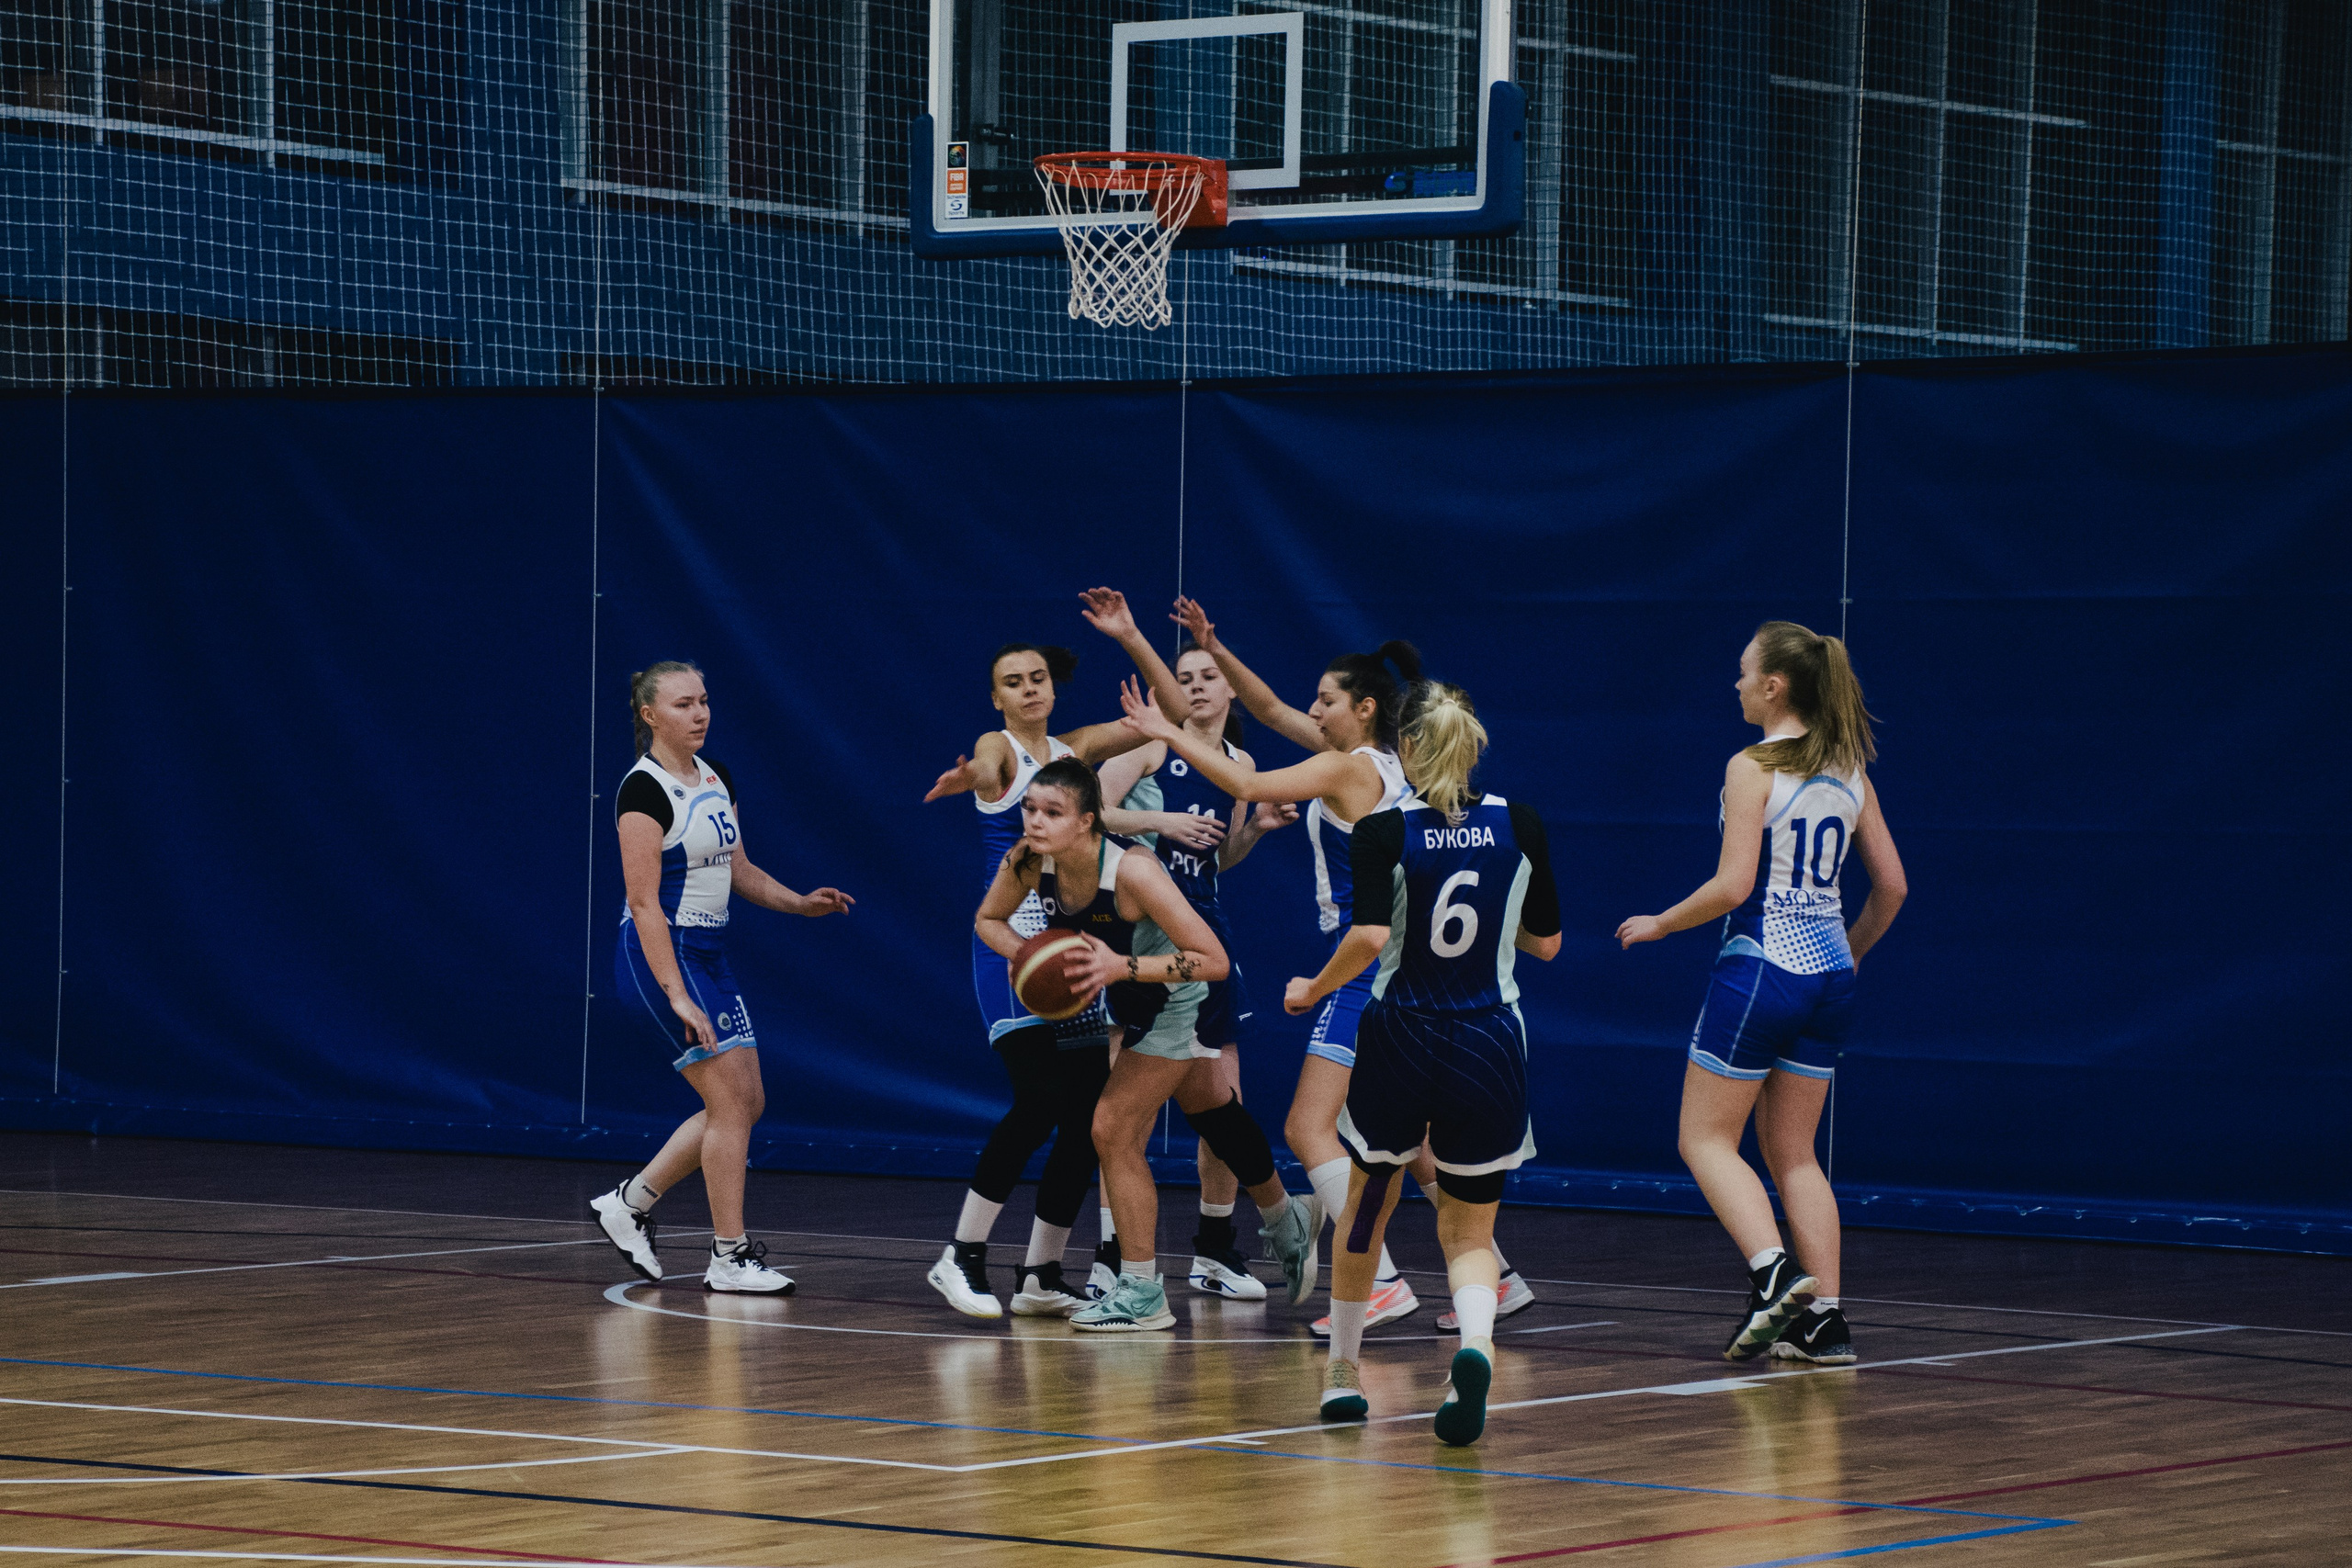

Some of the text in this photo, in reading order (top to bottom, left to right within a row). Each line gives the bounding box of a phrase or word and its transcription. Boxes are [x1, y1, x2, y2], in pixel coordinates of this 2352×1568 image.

[707, 811, 737, 848] 15
[1423, 826, 1496, 850] БУКОВА
[1791, 816, 1845, 888] 10
[1430, 869, 1480, 958] 6
